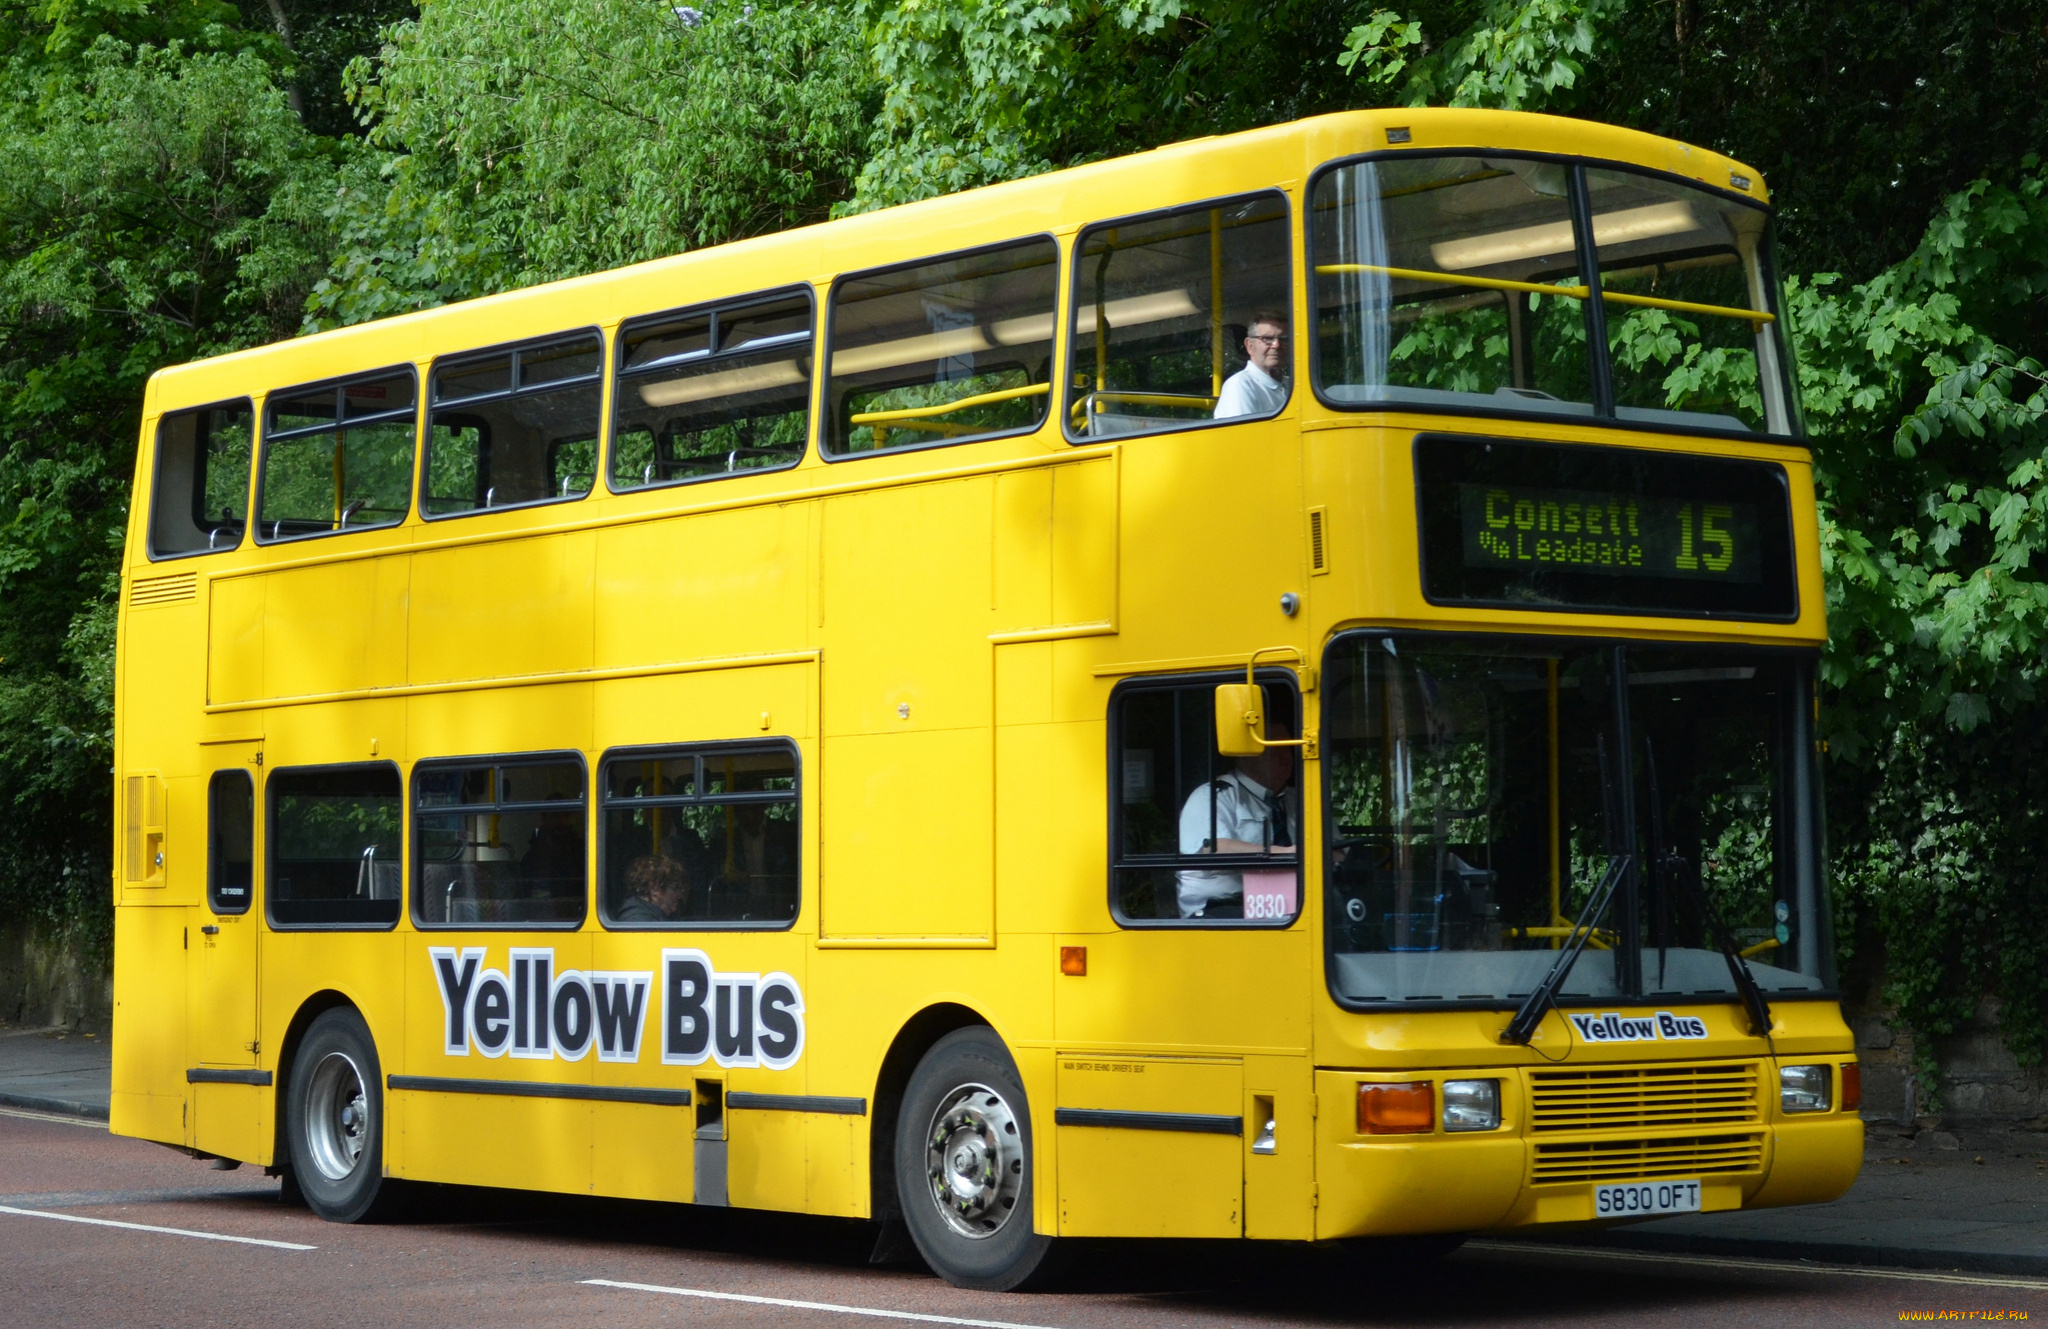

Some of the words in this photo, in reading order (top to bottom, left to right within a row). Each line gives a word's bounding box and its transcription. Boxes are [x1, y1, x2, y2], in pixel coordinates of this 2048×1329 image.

[1485, 489, 1640, 536] Consett
[1517, 534, 1643, 566] Leadgate
[1676, 503, 1733, 571] 15
[1246, 894, 1286, 918] 3830
[429, 947, 653, 1063] Yellow
[661, 948, 804, 1070] Bus
[1569, 1013, 1657, 1042] Yellow
[1656, 1011, 1708, 1040] Bus
[1599, 1186, 1653, 1213] S830
[1659, 1183, 1698, 1209] OFT
